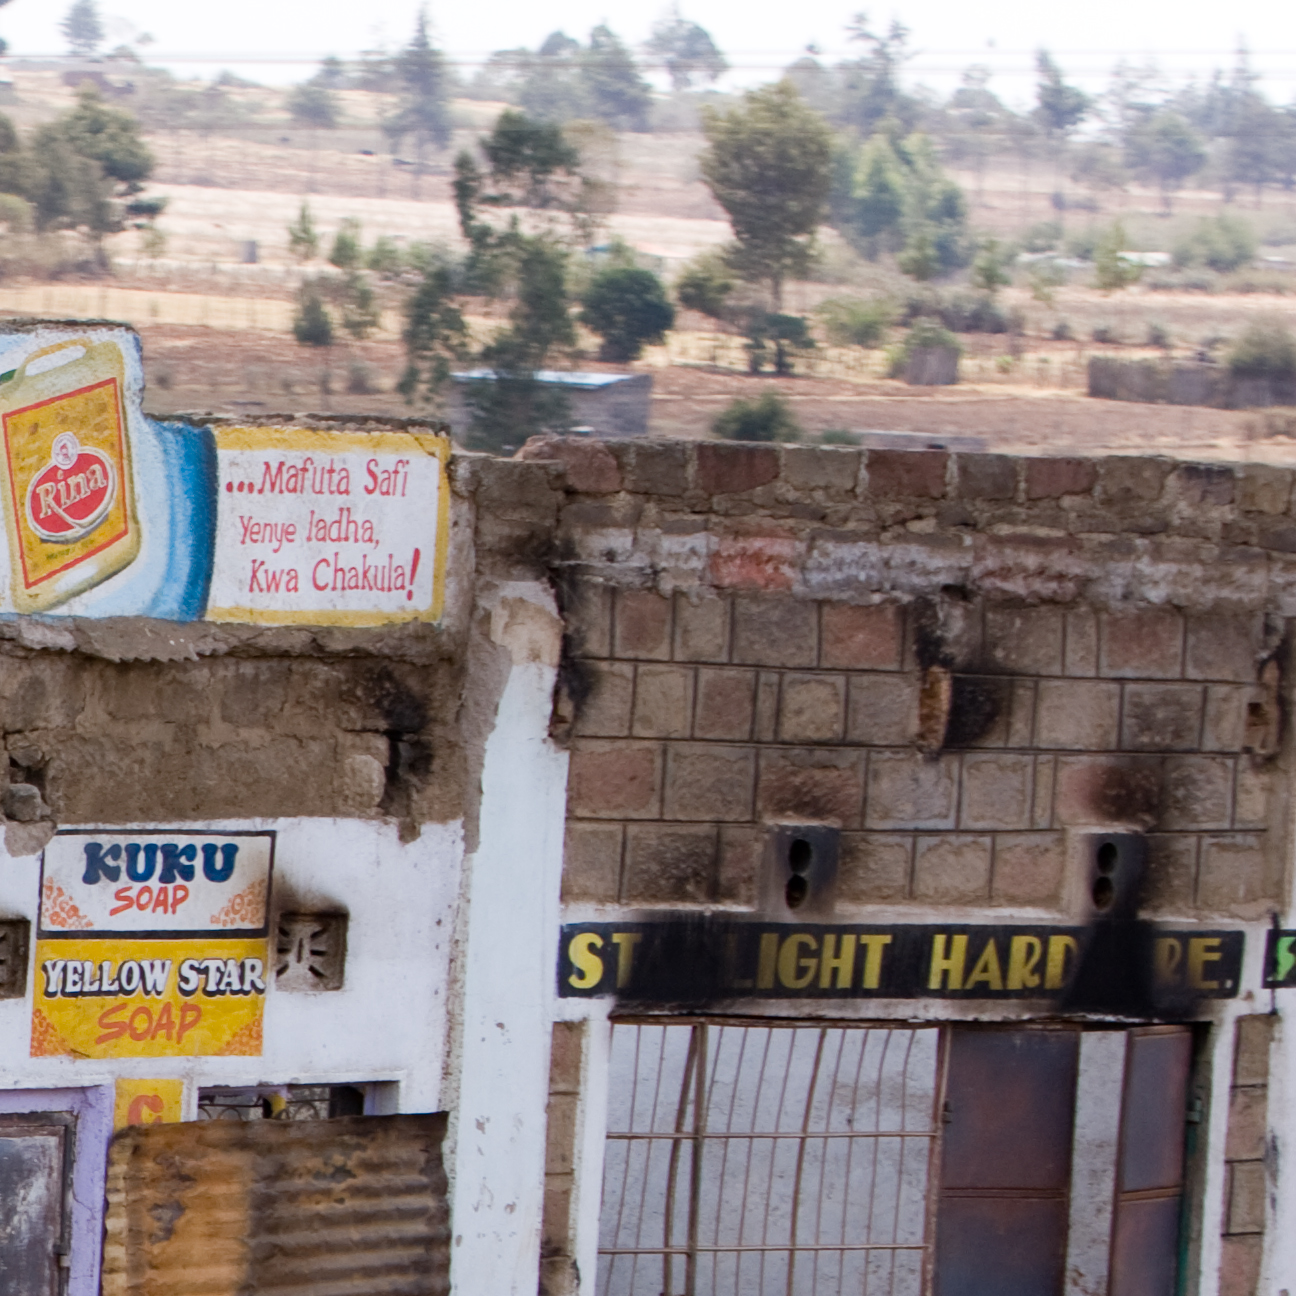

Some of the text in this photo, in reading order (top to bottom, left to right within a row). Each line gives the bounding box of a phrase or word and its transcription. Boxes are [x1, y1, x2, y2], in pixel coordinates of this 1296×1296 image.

[35, 461, 108, 520] Rina
[364, 459, 410, 497] Safi
[239, 510, 380, 553] Yenye ladha,
[249, 548, 419, 601] Kwa Chakula!
[82, 842, 238, 884] KUKU
[109, 884, 189, 916] SOAP
[42, 958, 266, 998] YELLOW STAR
[568, 932, 893, 990] STLIGHT
[929, 932, 1235, 990] HARDRE.
[95, 1002, 203, 1045] SOAP
